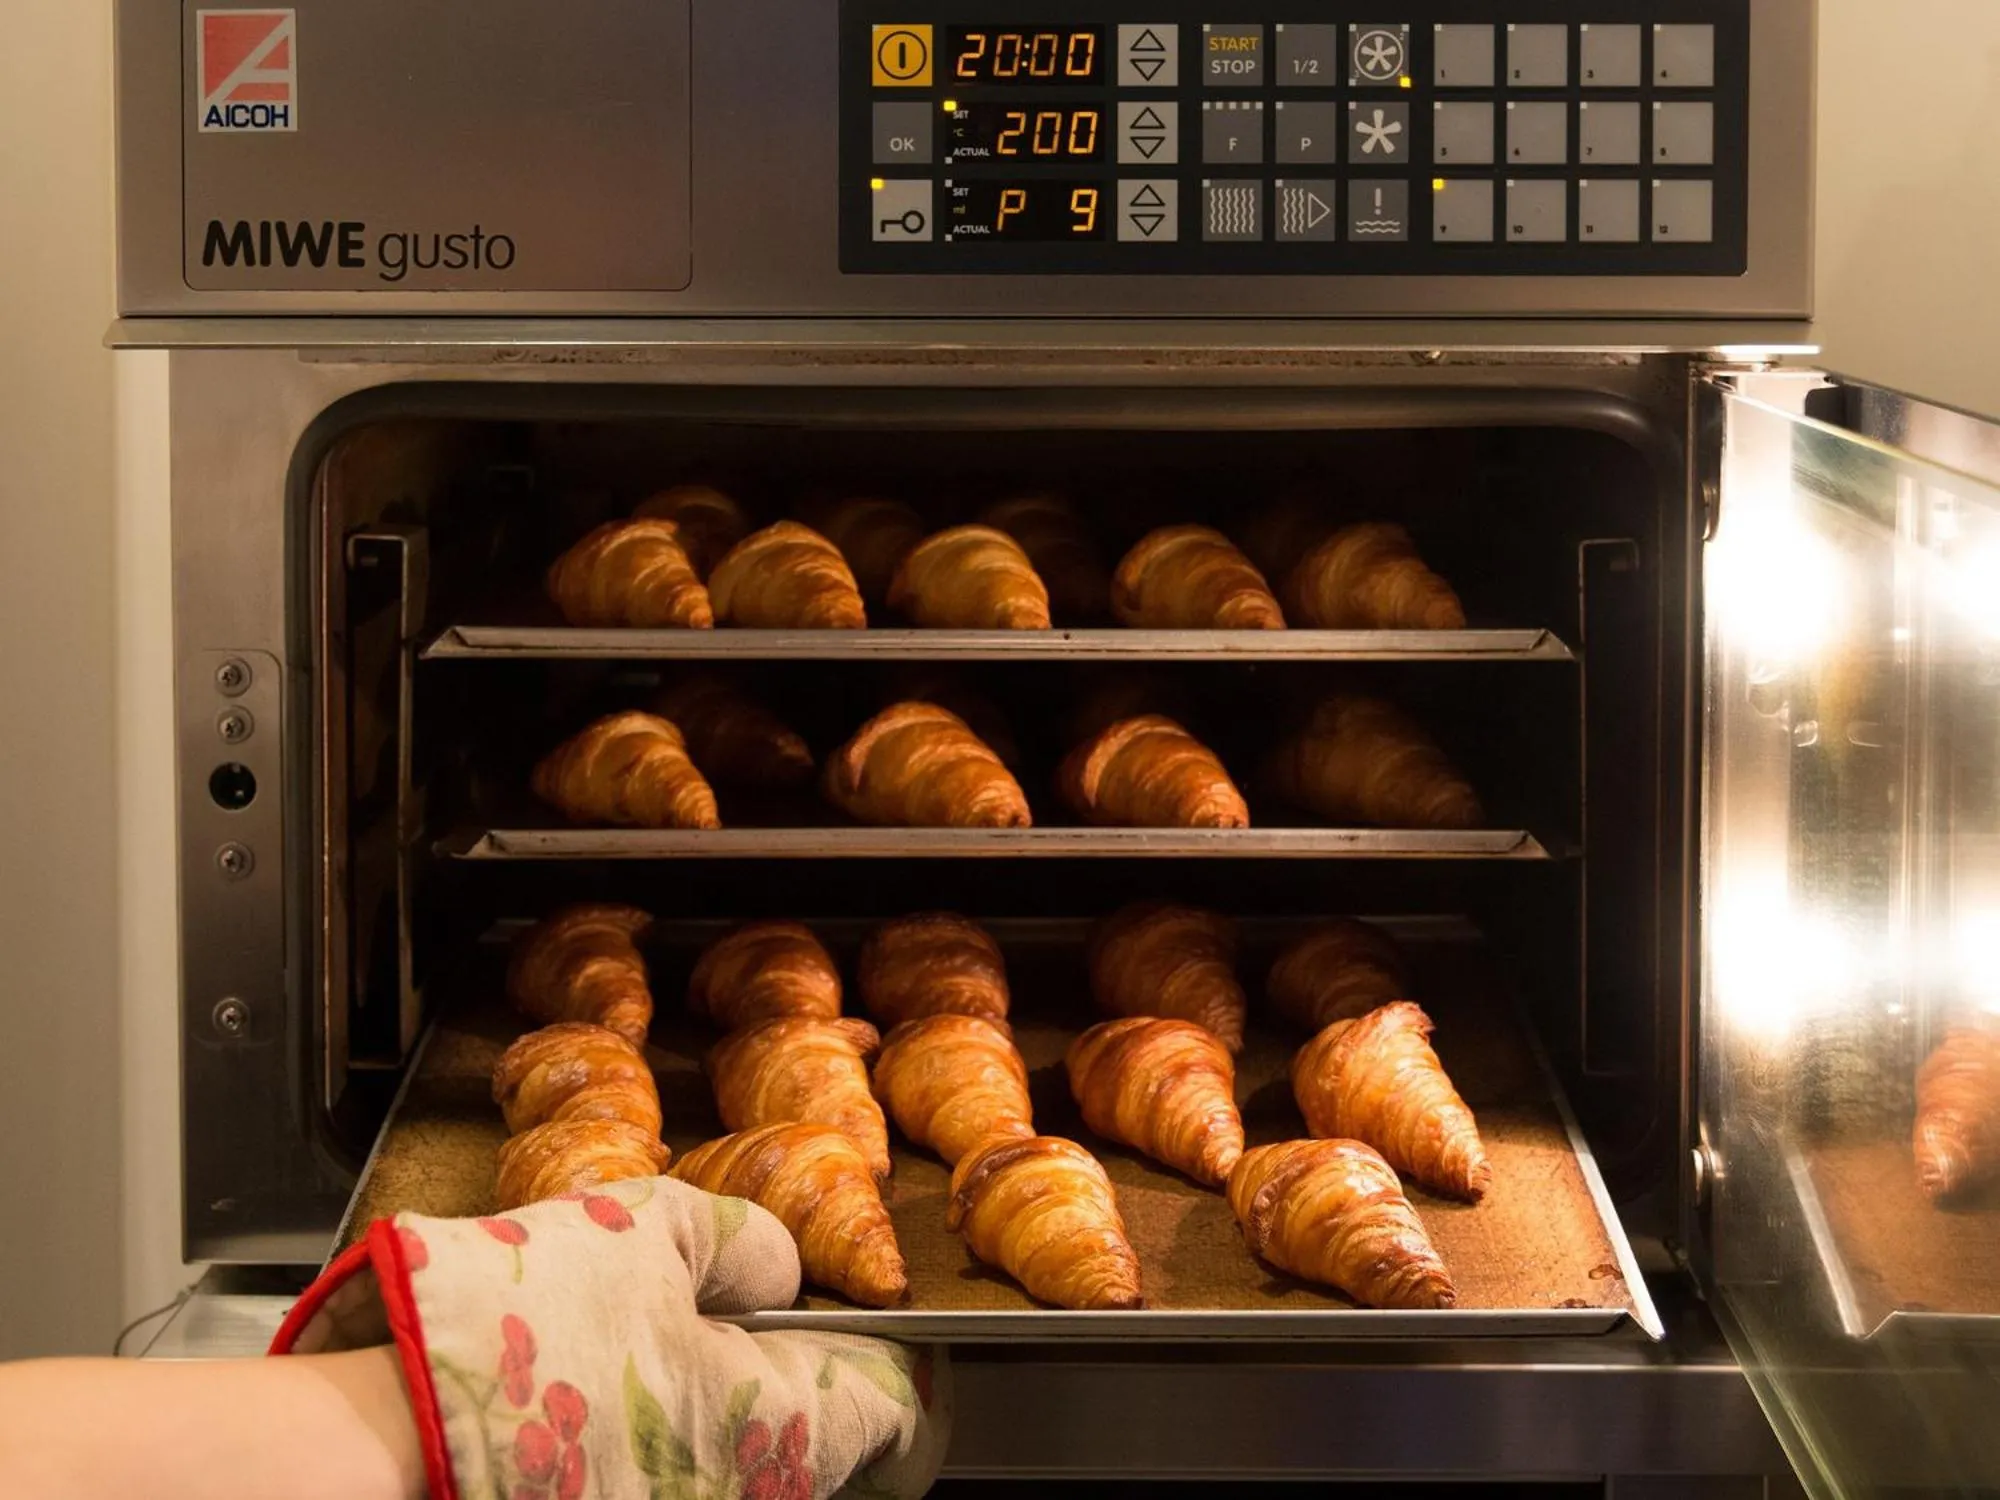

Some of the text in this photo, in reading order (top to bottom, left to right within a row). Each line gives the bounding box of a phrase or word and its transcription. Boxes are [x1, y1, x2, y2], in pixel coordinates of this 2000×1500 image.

[1209, 36, 1259, 51] START
[957, 33, 1095, 77] 20:00
[1211, 60, 1256, 74] STOP
[1293, 60, 1319, 74] 1/2
[204, 105, 289, 128] AICOH
[953, 110, 969, 119] SET
[997, 111, 1098, 154] 200
[890, 137, 915, 151] OK
[1229, 138, 1238, 151] F
[1301, 138, 1312, 151] P
[953, 147, 990, 156] ACTUAL
[953, 187, 969, 197] SET
[997, 189, 1098, 232] P 9
[953, 225, 990, 234] ACTUAL
[1513, 225, 1523, 234] 10
[1586, 225, 1593, 234] 11
[1659, 225, 1668, 234] 12
[202, 220, 516, 282] MIWE gusto
